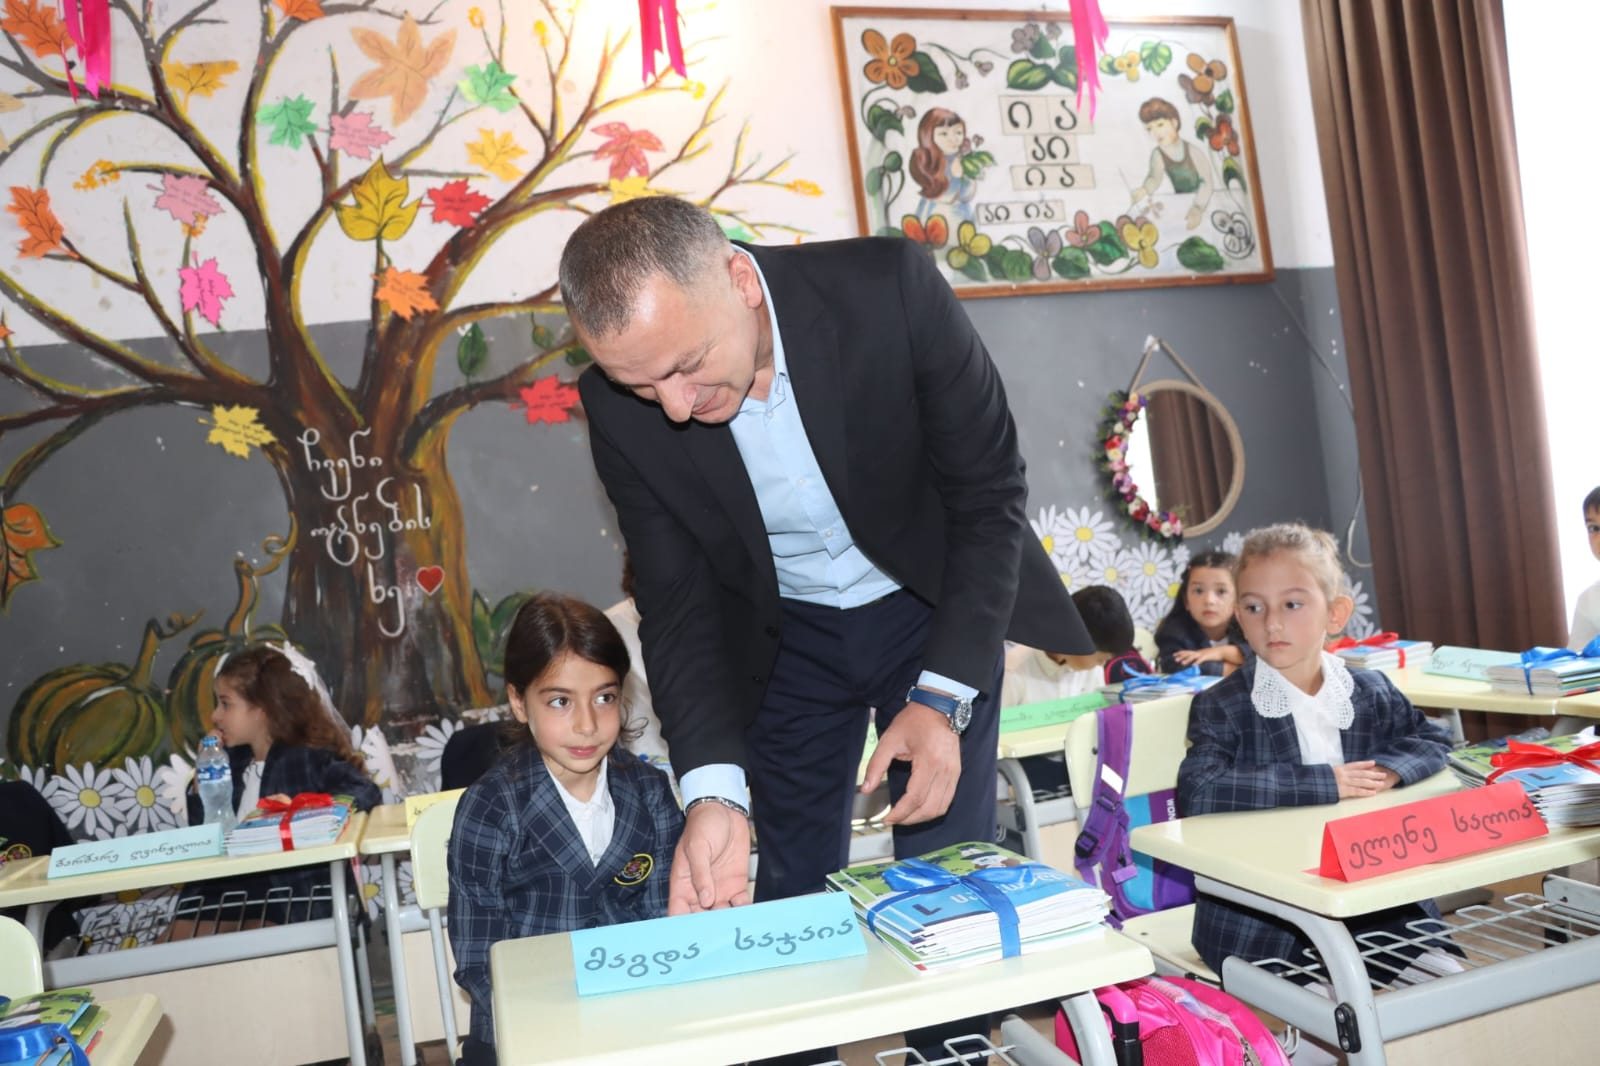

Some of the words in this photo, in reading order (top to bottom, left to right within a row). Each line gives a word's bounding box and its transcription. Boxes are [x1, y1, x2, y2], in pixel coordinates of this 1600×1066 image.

[296, 427, 383, 500] ჩვენი
[367, 562, 405, 637] ხე
[1348, 815, 1438, 869] ელენე
[1450, 802, 1533, 840] სალია
[583, 940, 701, 978] მაგდა
[734, 917, 854, 955] საჯაია
